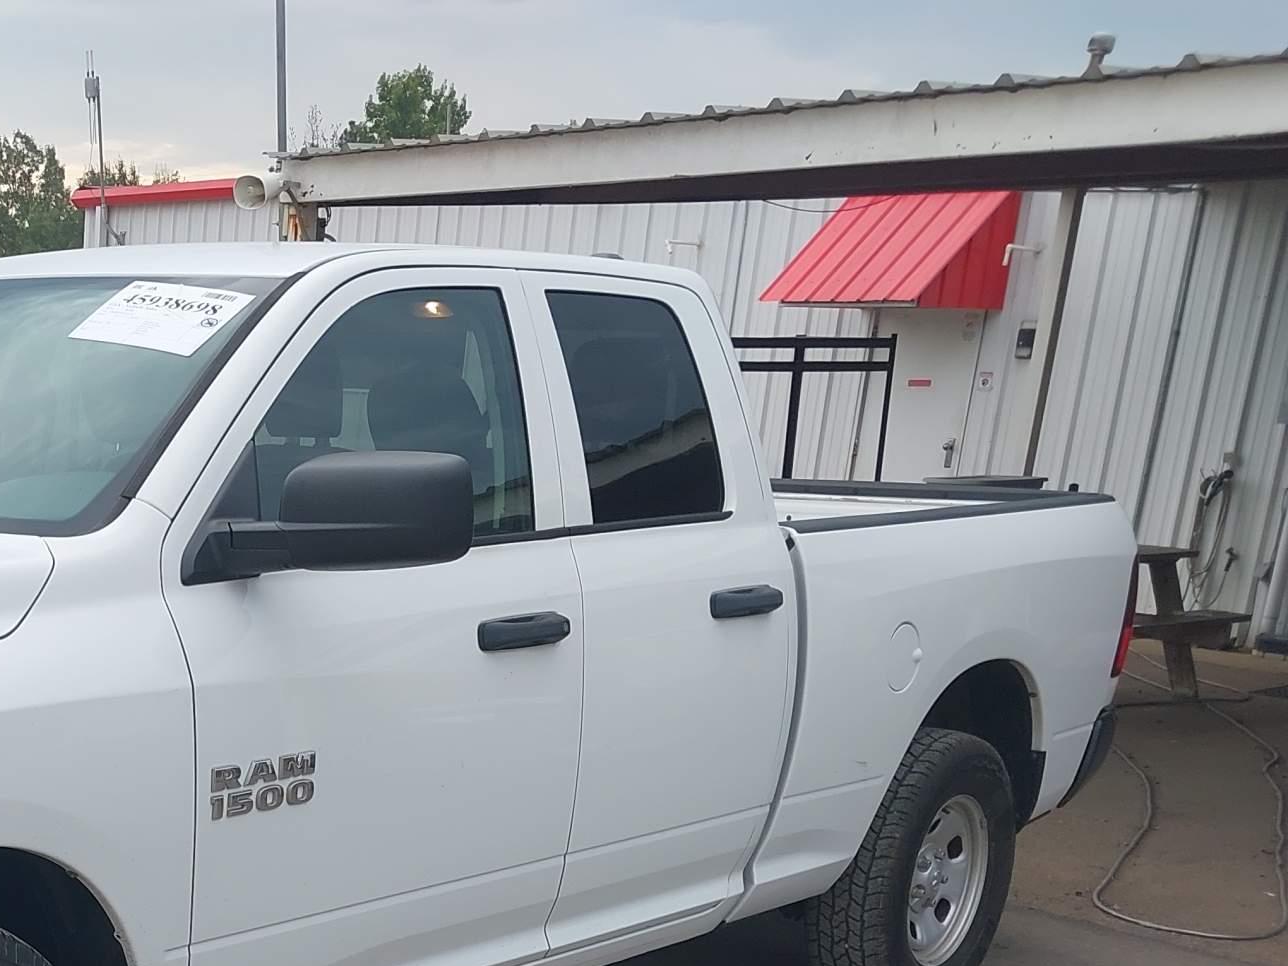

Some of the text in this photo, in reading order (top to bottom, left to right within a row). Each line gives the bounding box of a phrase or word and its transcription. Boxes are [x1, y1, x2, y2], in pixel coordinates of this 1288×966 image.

[122, 294, 223, 316] 45938698
[211, 750, 316, 793] RAM
[210, 778, 315, 821] 1500
